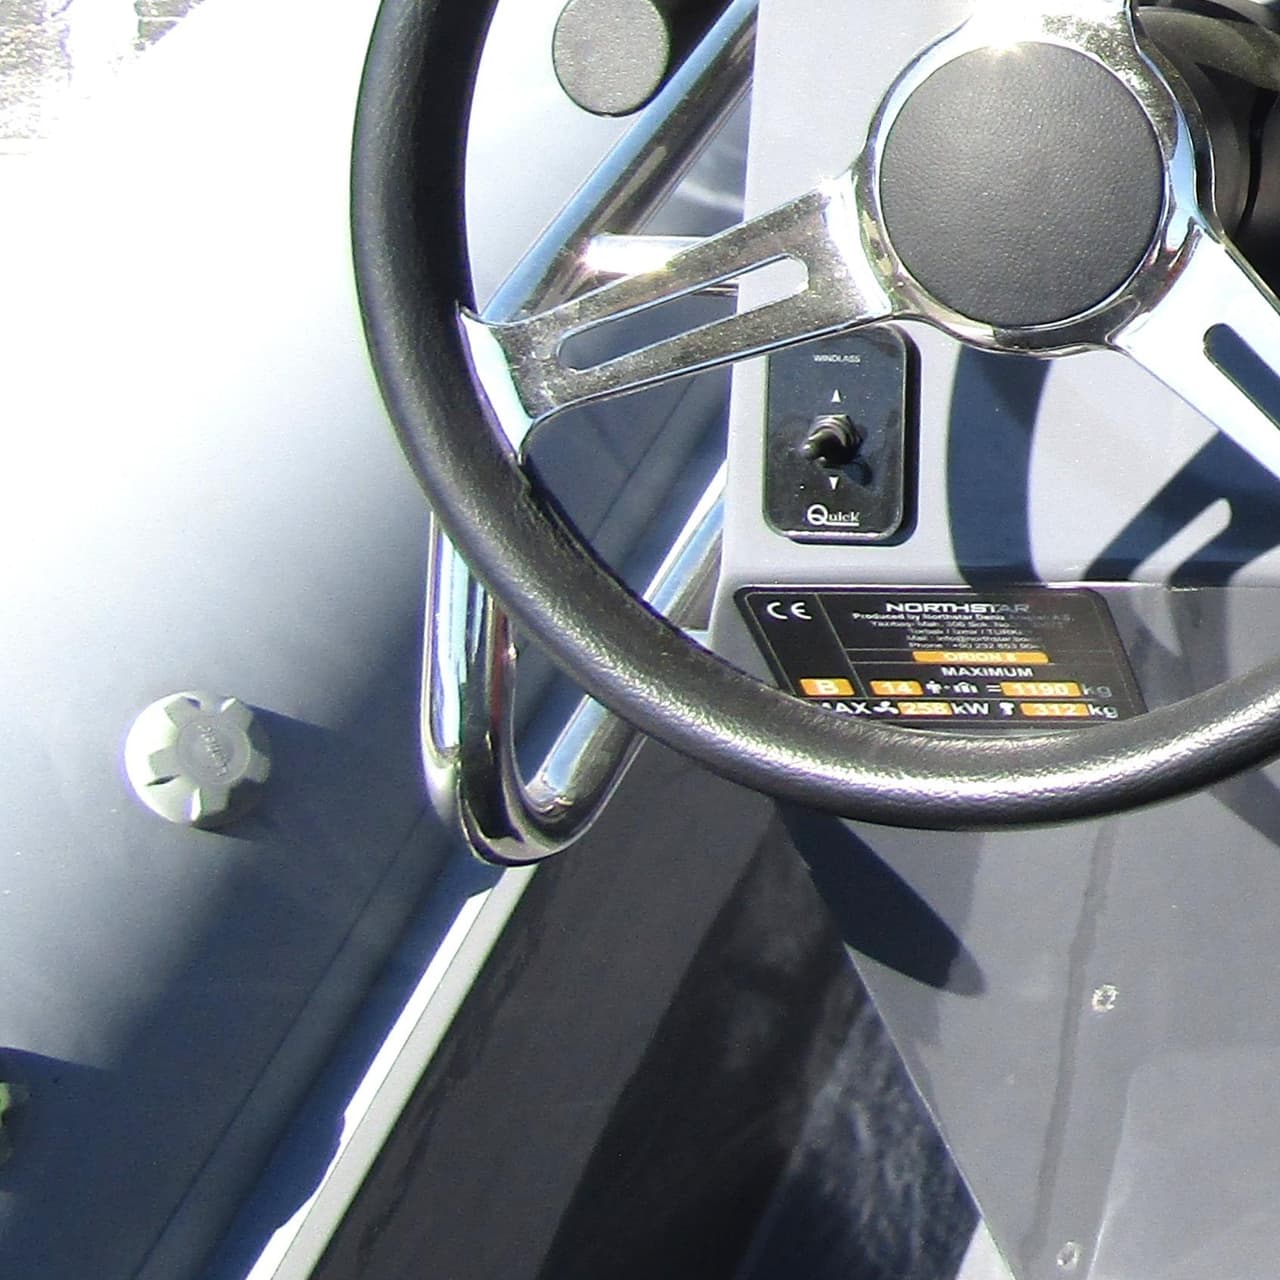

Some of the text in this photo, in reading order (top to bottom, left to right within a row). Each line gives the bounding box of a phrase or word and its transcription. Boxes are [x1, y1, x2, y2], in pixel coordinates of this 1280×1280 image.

[807, 504, 860, 526] Quick
[885, 602, 1030, 613] NORTHSTAR
[852, 612, 905, 621] Produced
[923, 613, 974, 621] Northstar
[941, 666, 1033, 678] MAXIMUM
[818, 680, 839, 694] B
[886, 682, 912, 695] 14
[1081, 683, 1112, 699] kg
[951, 701, 991, 716] kW
[1033, 703, 1077, 717] 312
[1089, 703, 1119, 719] kg
